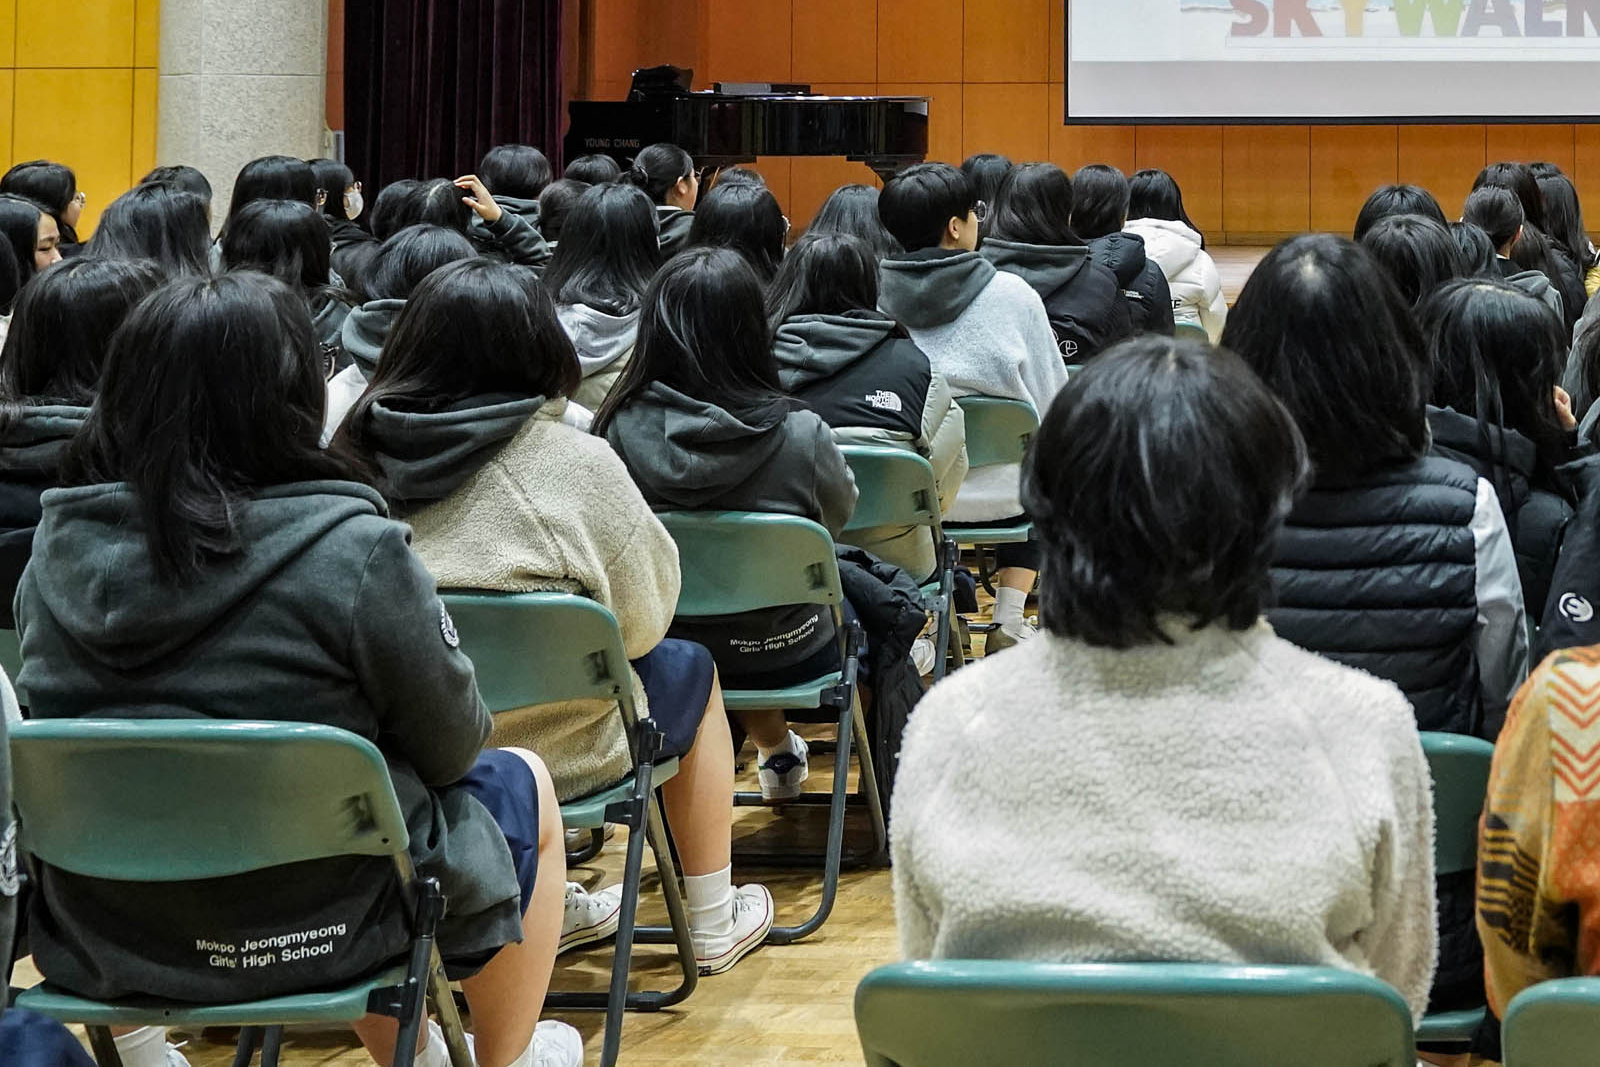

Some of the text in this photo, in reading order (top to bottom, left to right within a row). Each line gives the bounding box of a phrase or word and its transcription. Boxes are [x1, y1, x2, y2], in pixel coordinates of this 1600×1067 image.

[584, 138, 610, 148] YOUNG
[196, 923, 347, 954] Mokpo Jeongmyeong
[209, 941, 334, 969] Girls' High School
